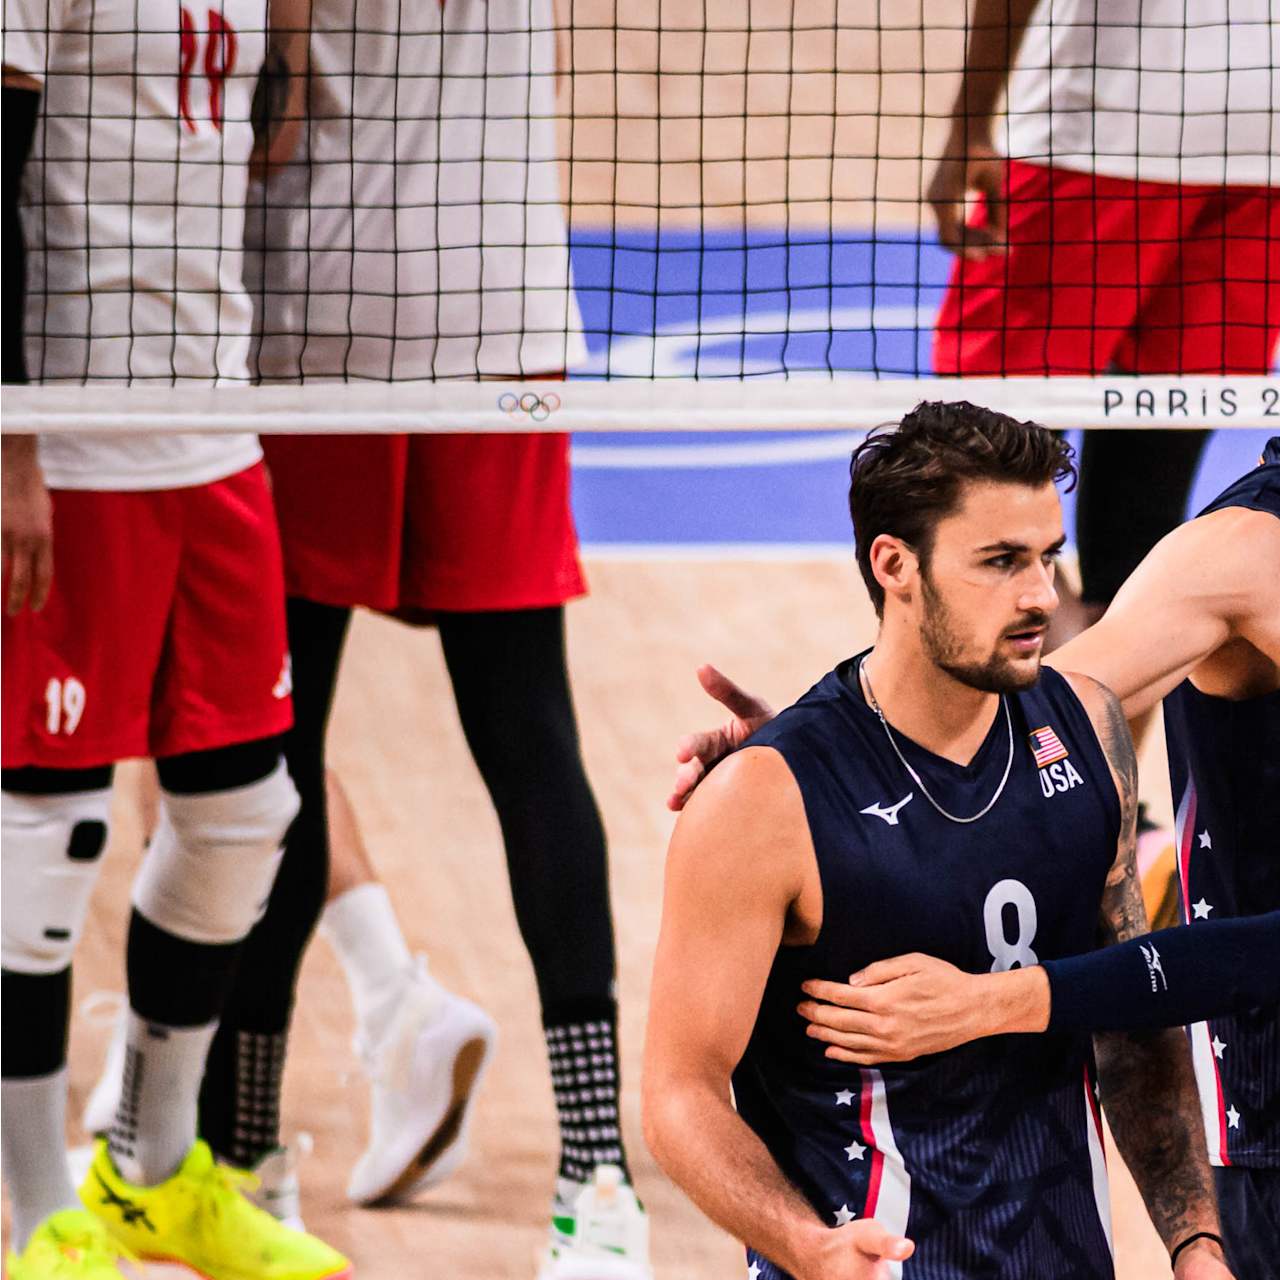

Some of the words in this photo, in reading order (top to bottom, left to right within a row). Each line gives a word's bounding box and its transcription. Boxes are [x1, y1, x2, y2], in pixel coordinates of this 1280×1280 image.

[45, 675, 87, 736] 19
[1038, 758, 1085, 799] USA
[982, 878, 1039, 974] 8
